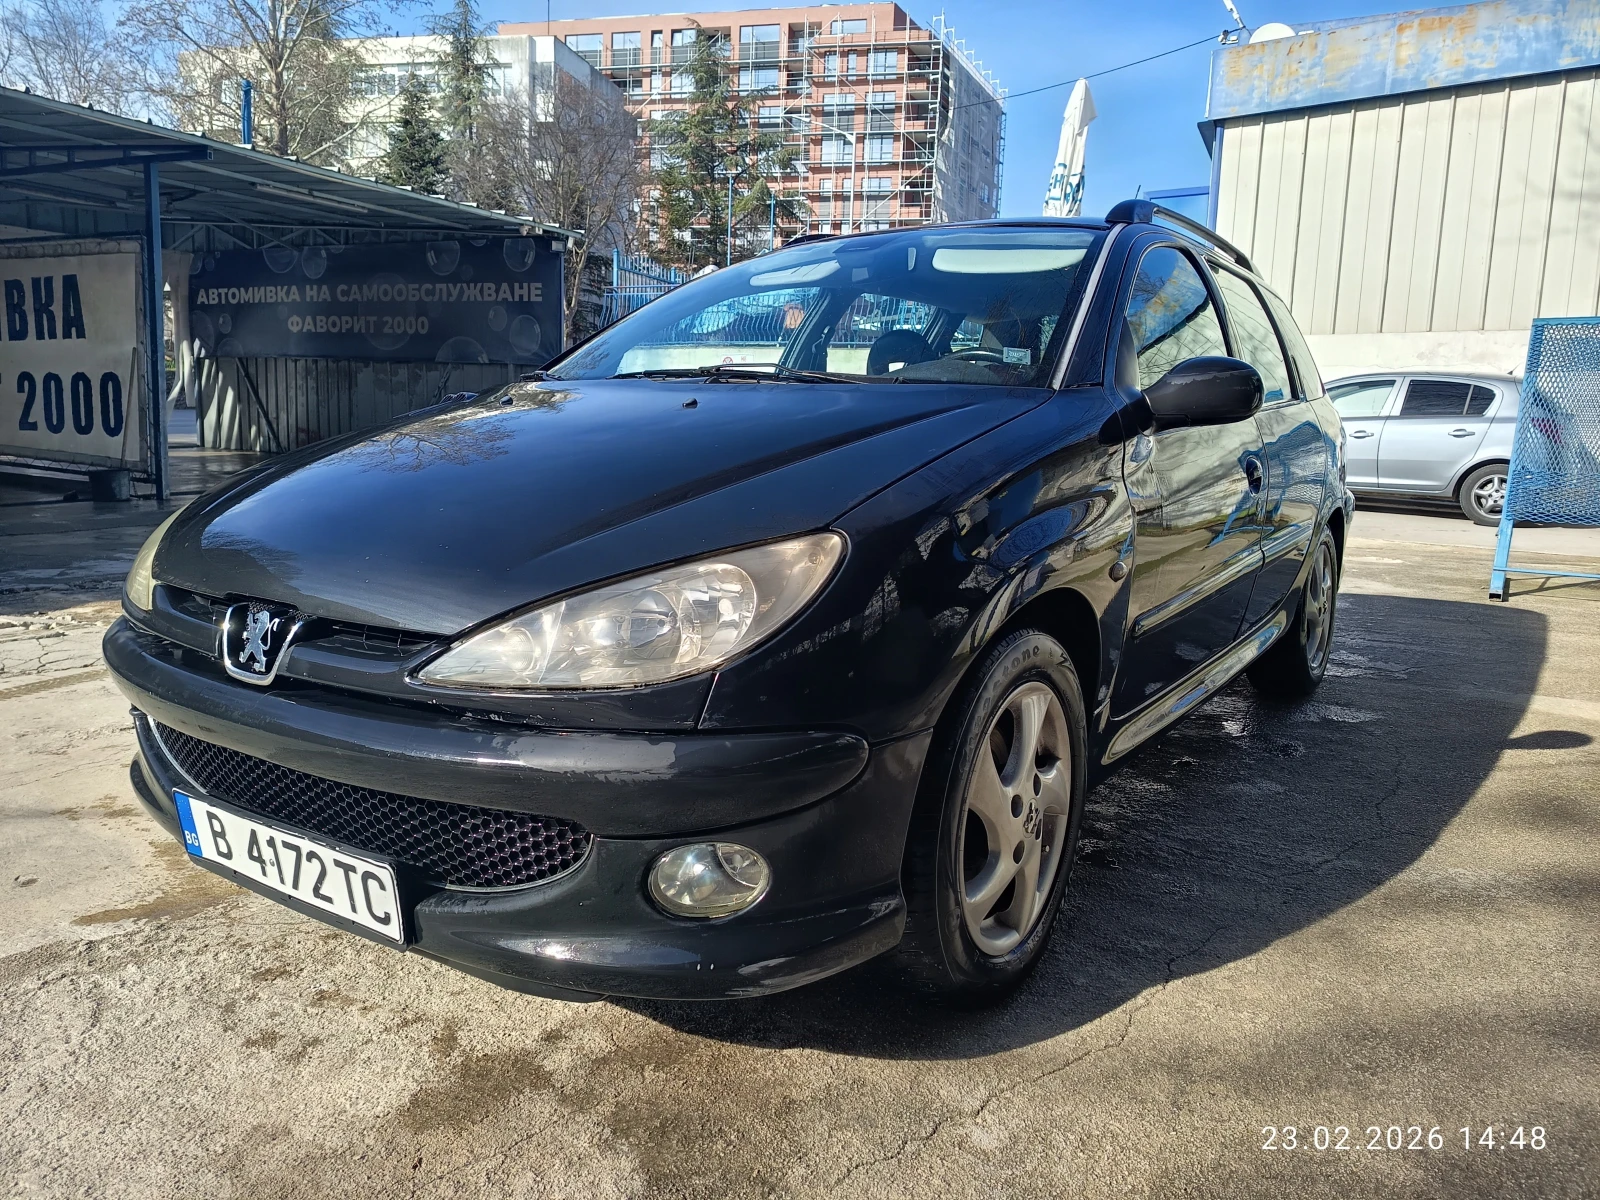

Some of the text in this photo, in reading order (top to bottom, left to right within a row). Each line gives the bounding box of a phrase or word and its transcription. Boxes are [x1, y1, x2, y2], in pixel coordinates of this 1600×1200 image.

[197, 282, 542, 304] АВТОМИВКА НА САМООБСЛУЖВАНЕ
[0, 274, 86, 341] ВКА
[287, 315, 429, 334] ФАВОРИТ 2000
[17, 371, 123, 437] 2000
[185, 830, 199, 847] BG
